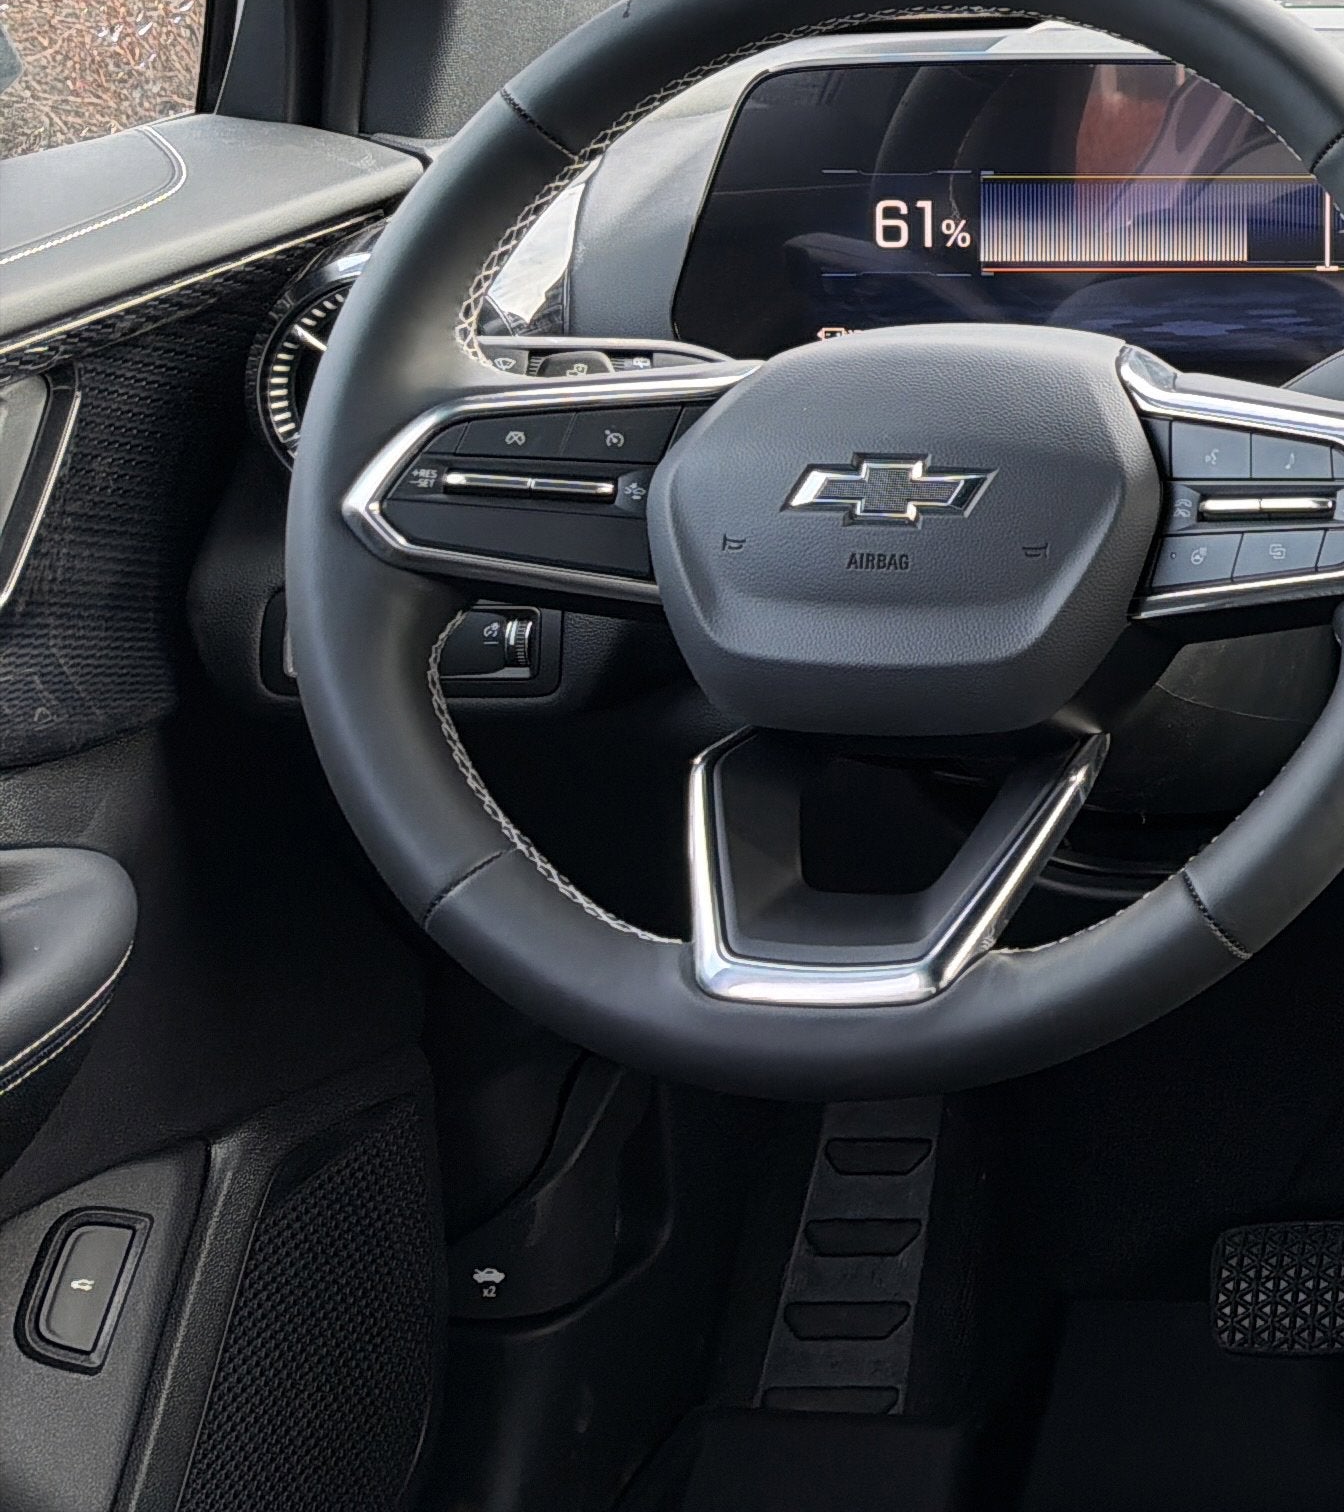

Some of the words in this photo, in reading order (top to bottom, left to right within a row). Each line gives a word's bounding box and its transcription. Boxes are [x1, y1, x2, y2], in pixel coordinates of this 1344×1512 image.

[875, 199, 971, 248] 61%
[847, 552, 910, 571] AIRBAG
[482, 1285, 497, 1298] x2
